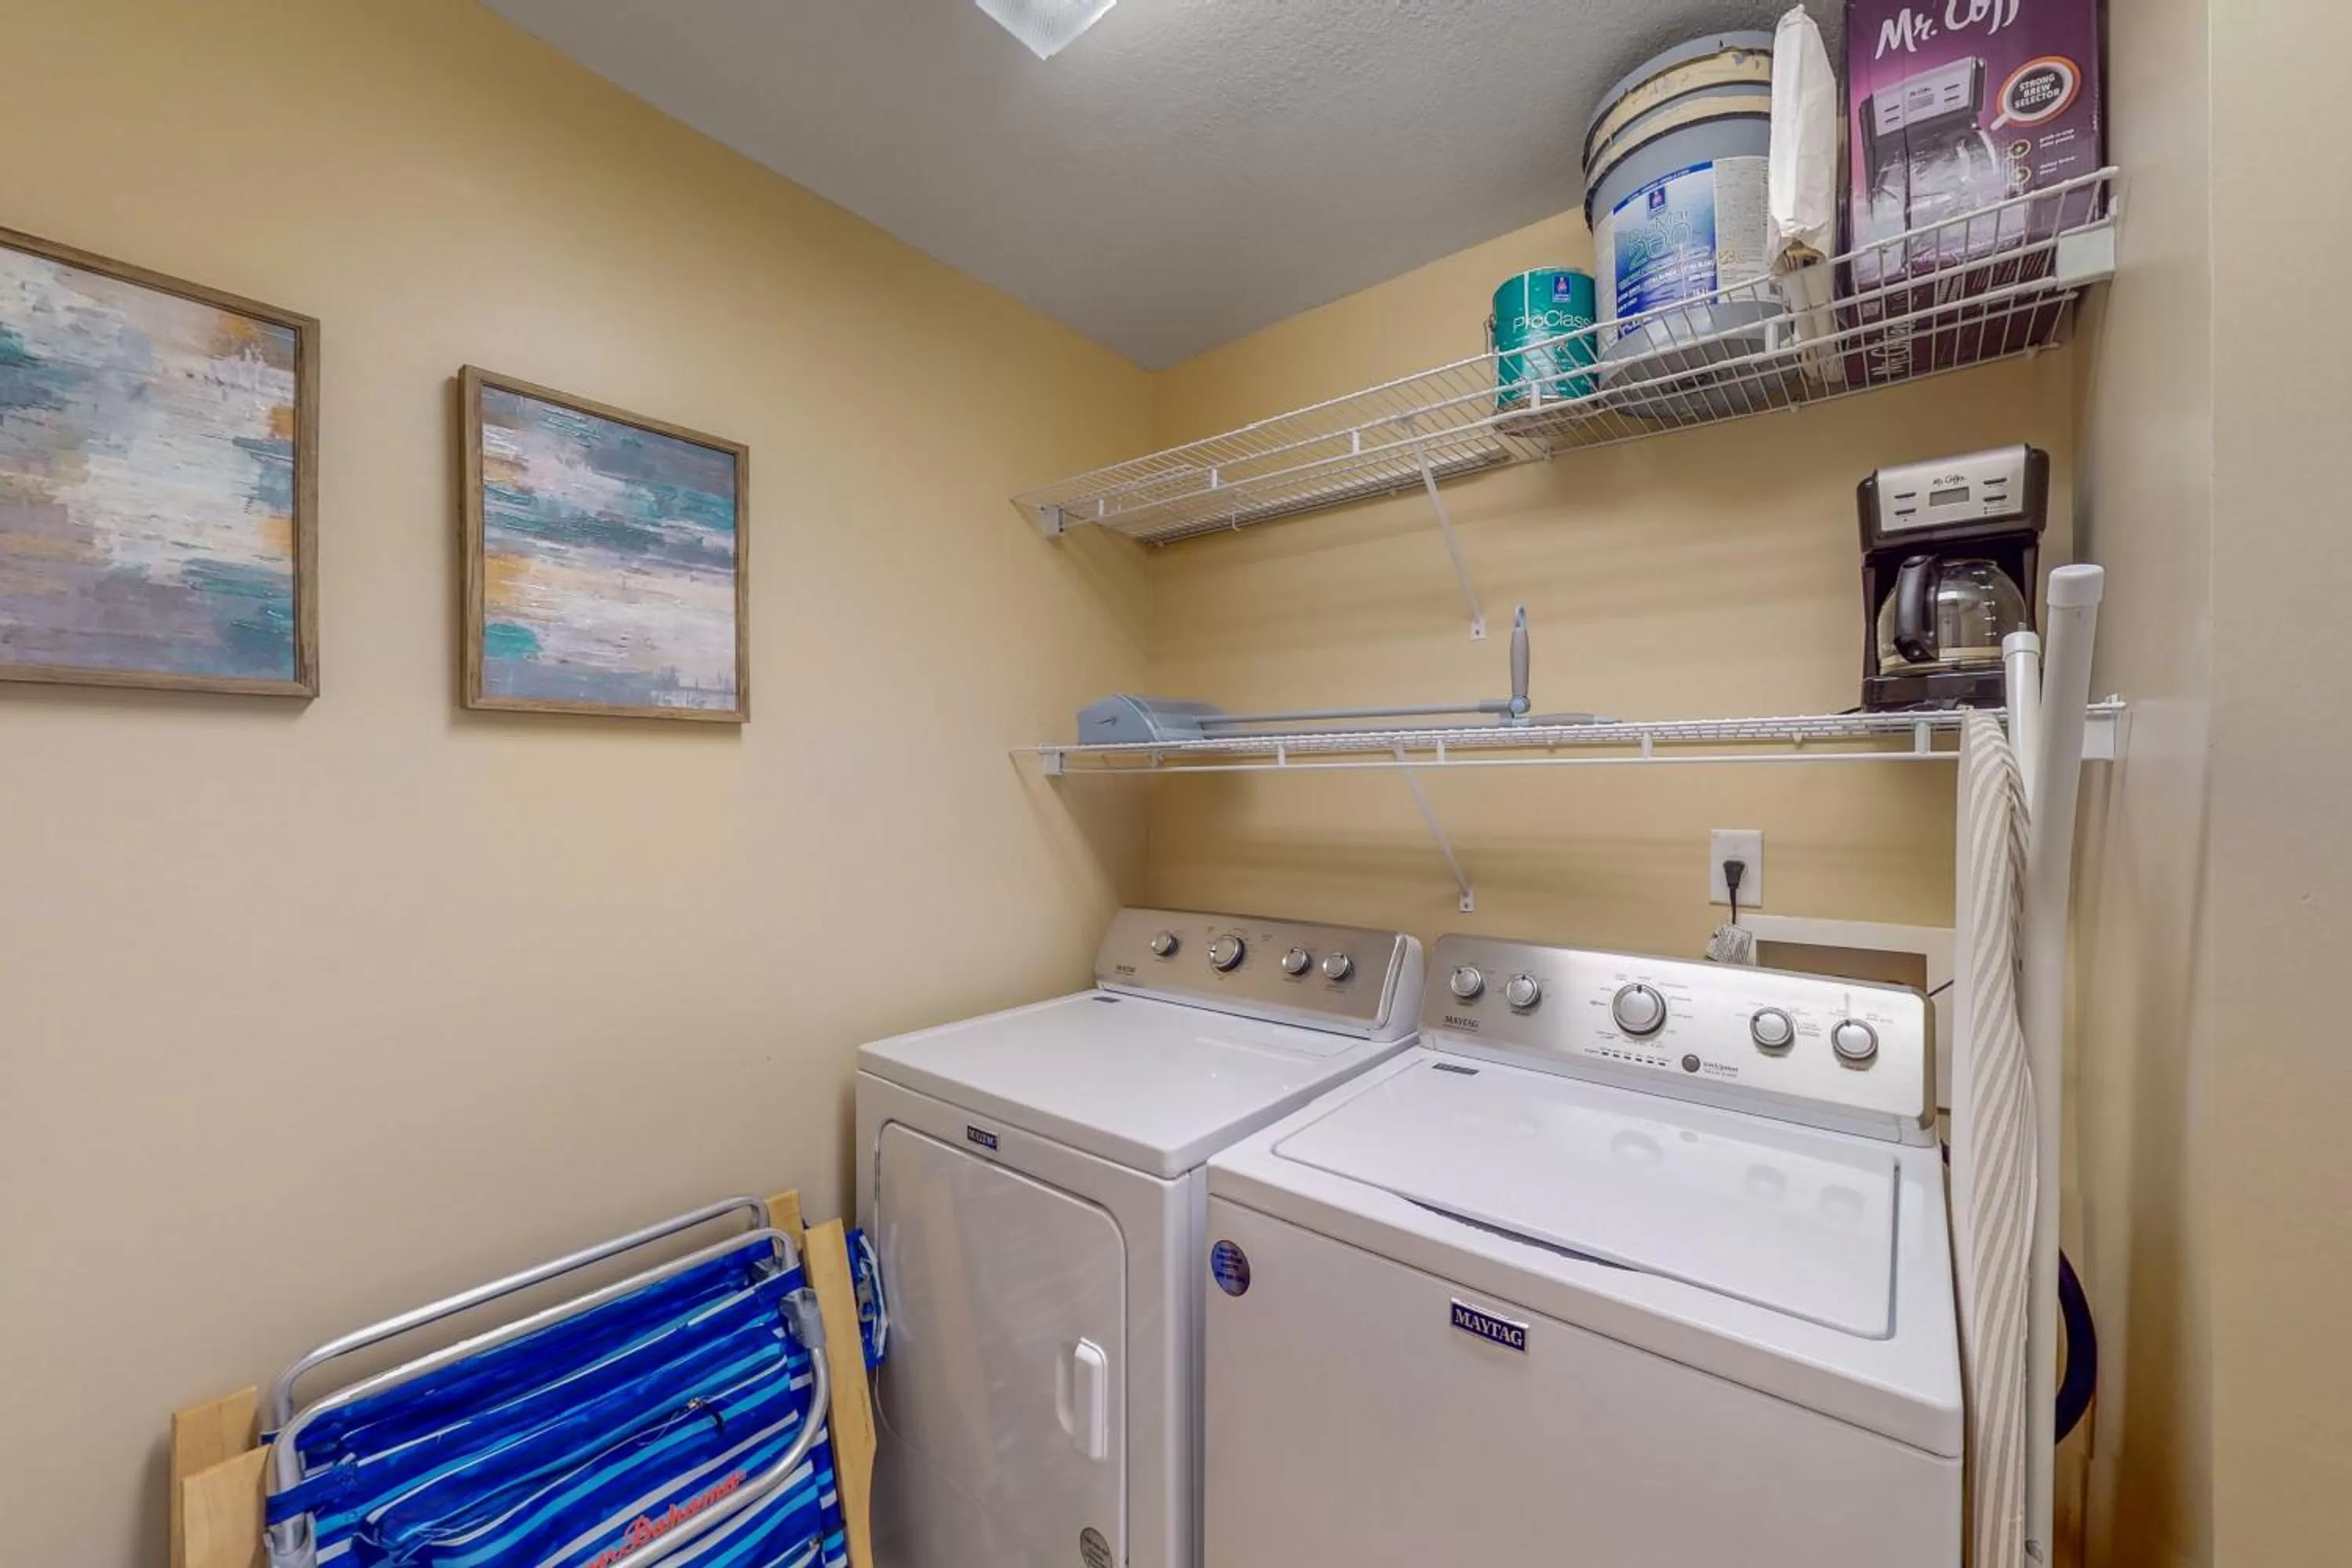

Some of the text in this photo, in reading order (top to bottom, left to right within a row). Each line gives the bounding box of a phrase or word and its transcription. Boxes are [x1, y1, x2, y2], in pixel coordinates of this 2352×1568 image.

[1875, 8, 1937, 60] Mr.
[2019, 73, 2056, 92] STRONG
[2024, 82, 2051, 98] BREW
[2014, 87, 2060, 108] SELECTOR
[1454, 1308, 1523, 1347] MAYTAG
